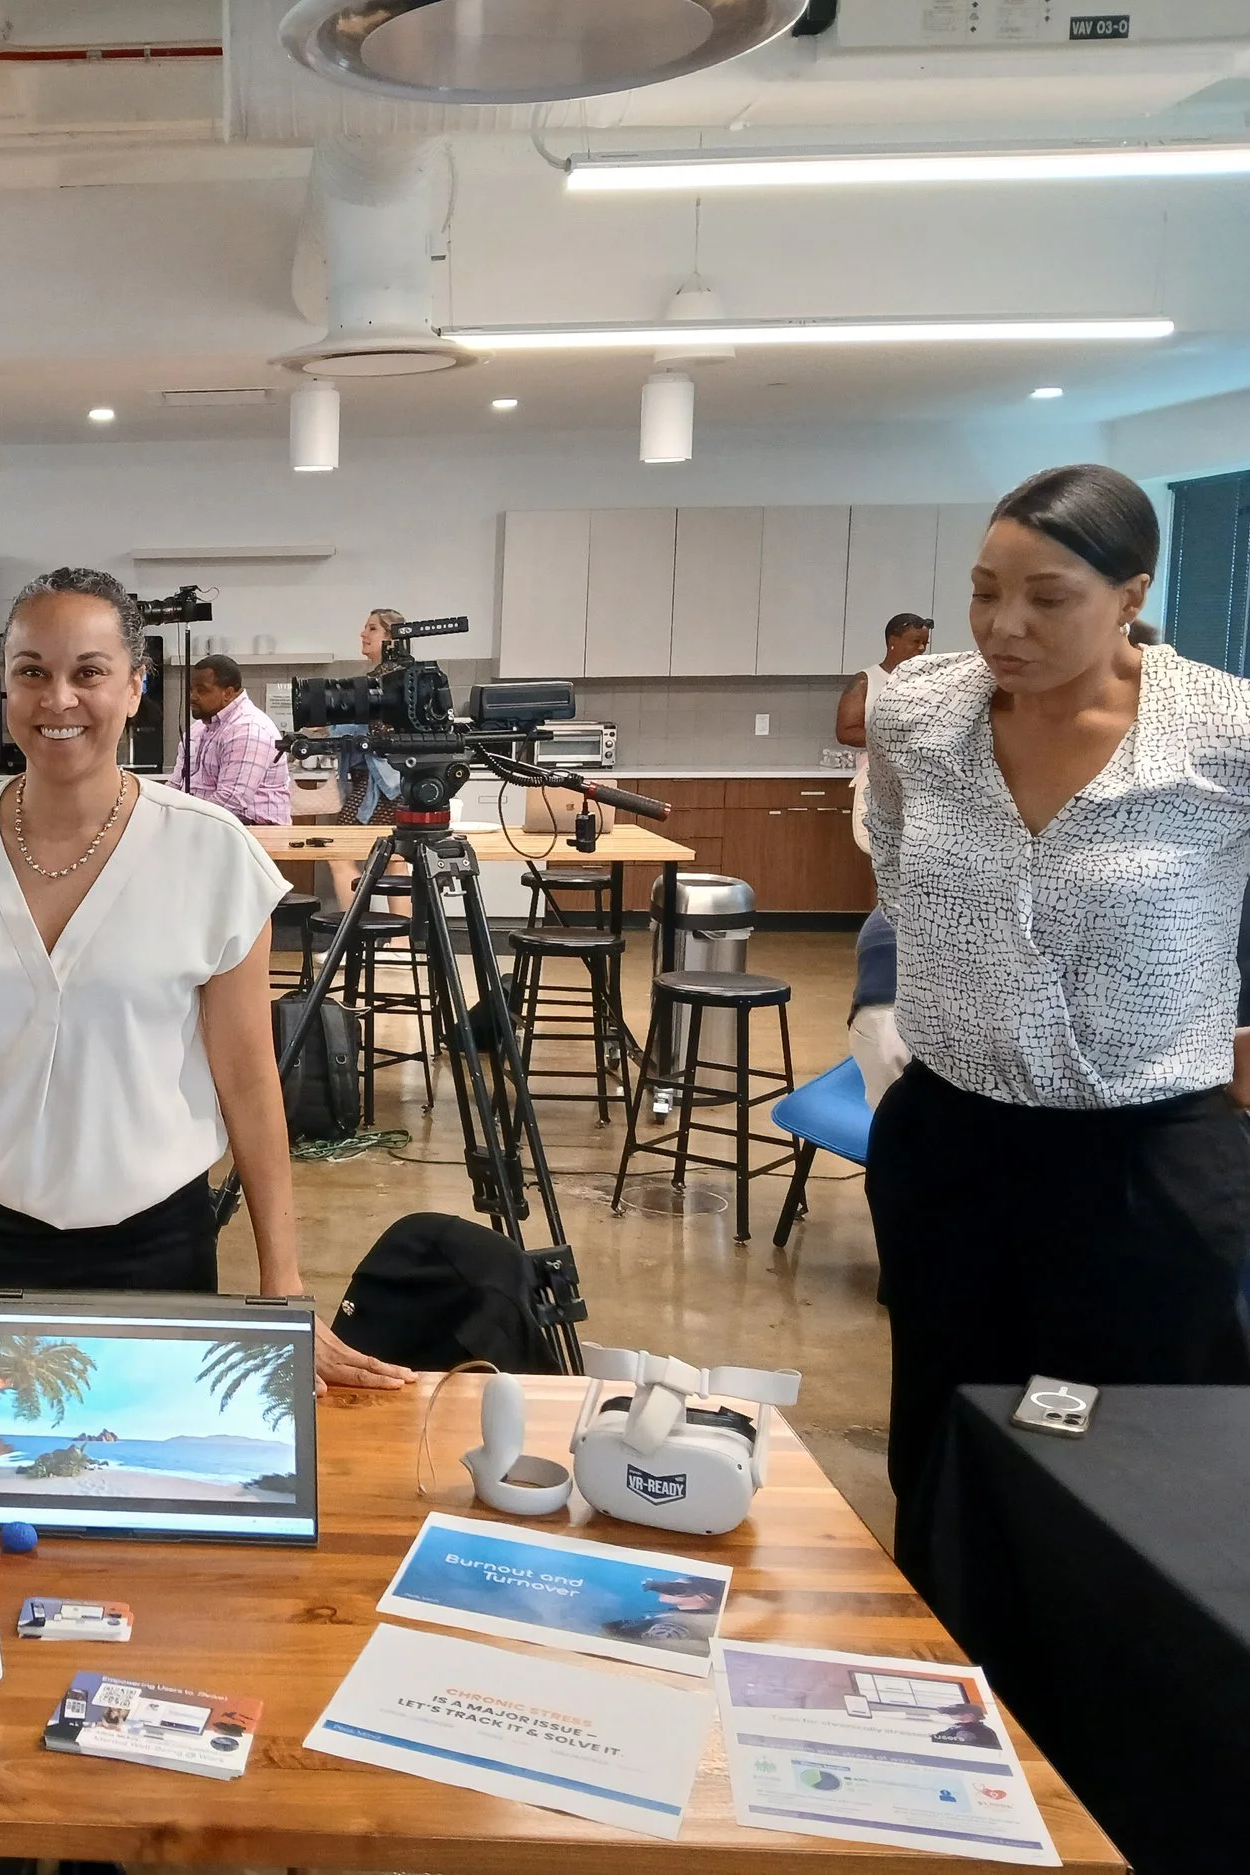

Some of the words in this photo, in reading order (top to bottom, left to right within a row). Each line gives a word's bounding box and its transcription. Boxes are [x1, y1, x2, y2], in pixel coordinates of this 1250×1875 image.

[1072, 21, 1093, 35] VAV
[628, 1475, 684, 1496] VR-READY
[445, 1553, 534, 1578] Burnout
[540, 1572, 585, 1587] and
[483, 1570, 580, 1597] Turnover
[432, 1695, 447, 1704] IS
[450, 1700, 462, 1708] A
[466, 1703, 530, 1724] MAJOR
[533, 1719, 583, 1737] ISSUE
[445, 1688, 526, 1712] CHRONIC
[530, 1707, 594, 1728] STRESS
[445, 1708, 502, 1728] TRACK
[506, 1723, 523, 1733] IT
[526, 1729, 539, 1738] &
[544, 1732, 600, 1752] SOLVE
